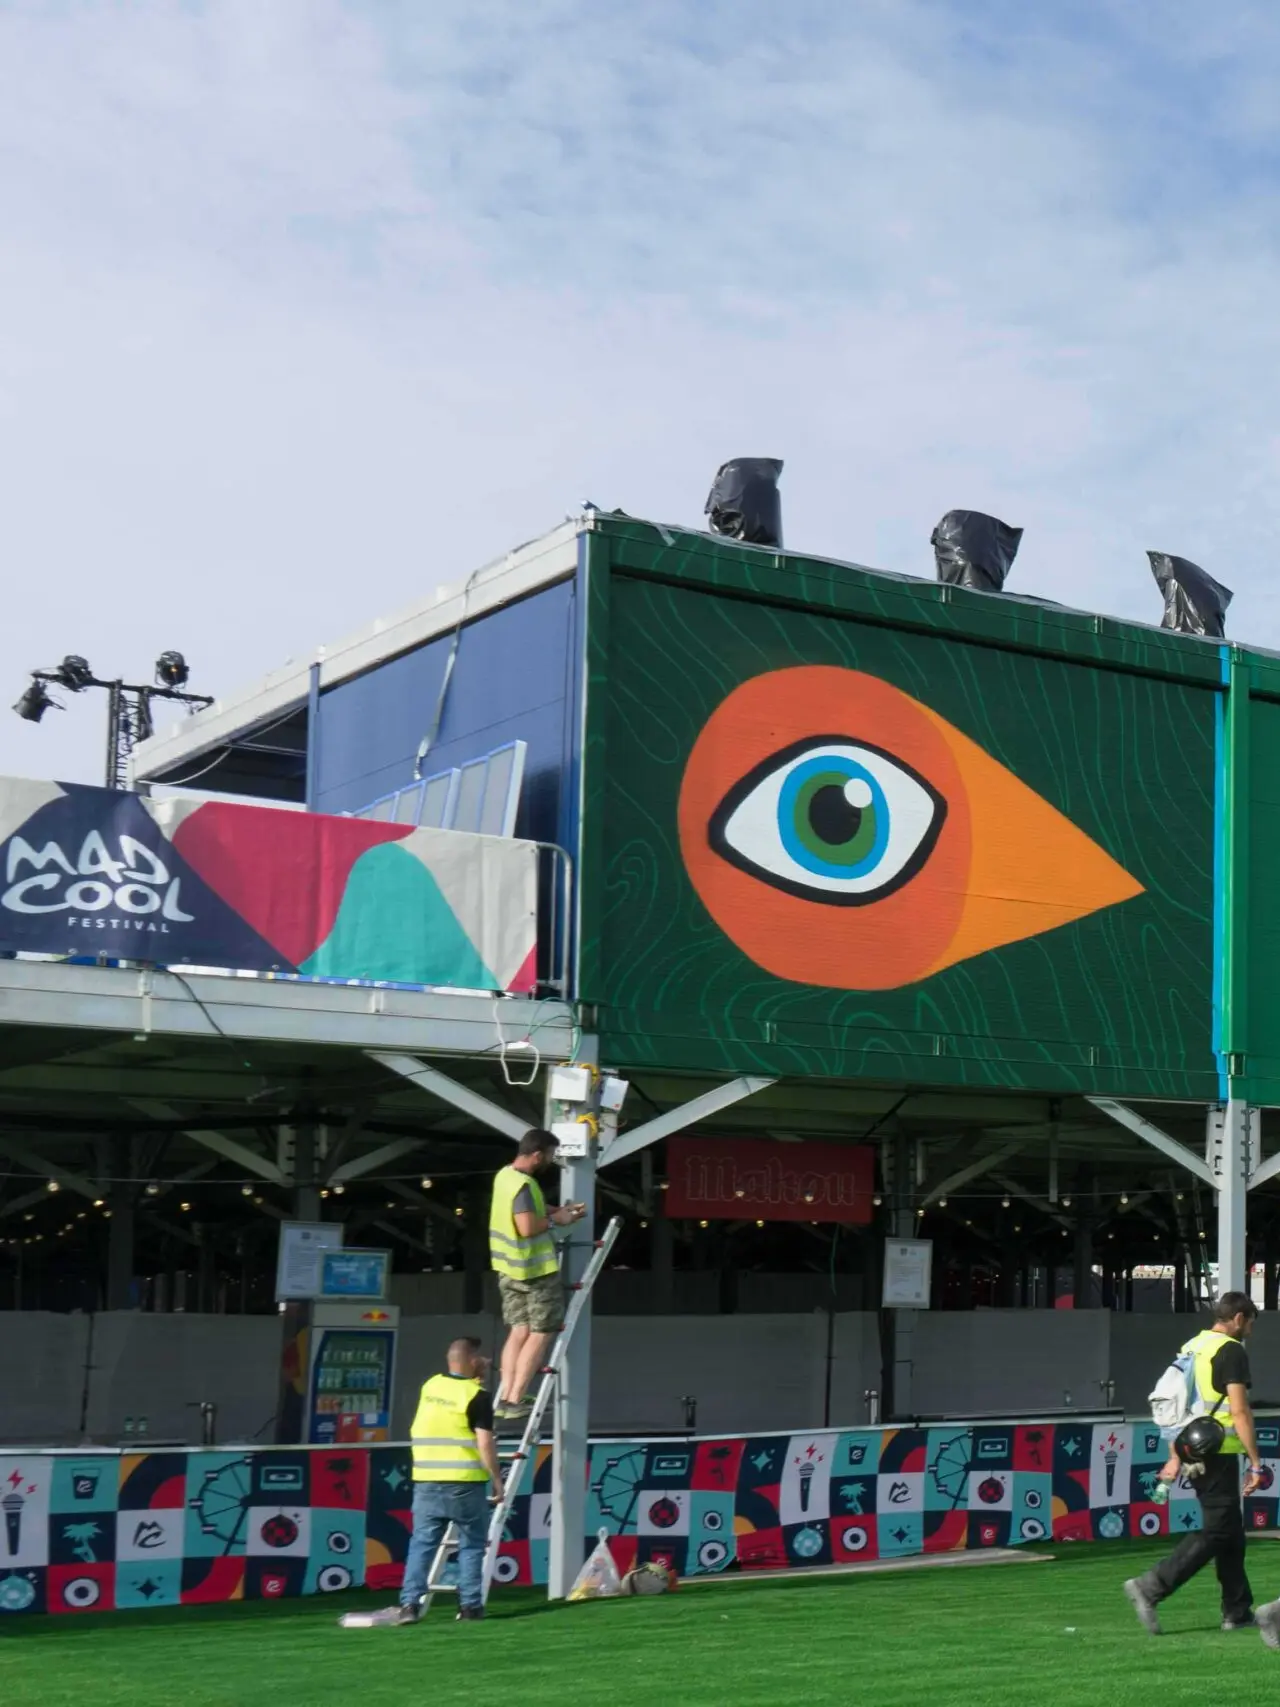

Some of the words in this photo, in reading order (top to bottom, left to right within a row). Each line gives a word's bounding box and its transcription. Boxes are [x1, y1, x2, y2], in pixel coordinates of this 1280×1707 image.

[7, 829, 170, 884] MAD
[1, 873, 195, 922] COOL
[68, 917, 169, 933] FESTIVAL
